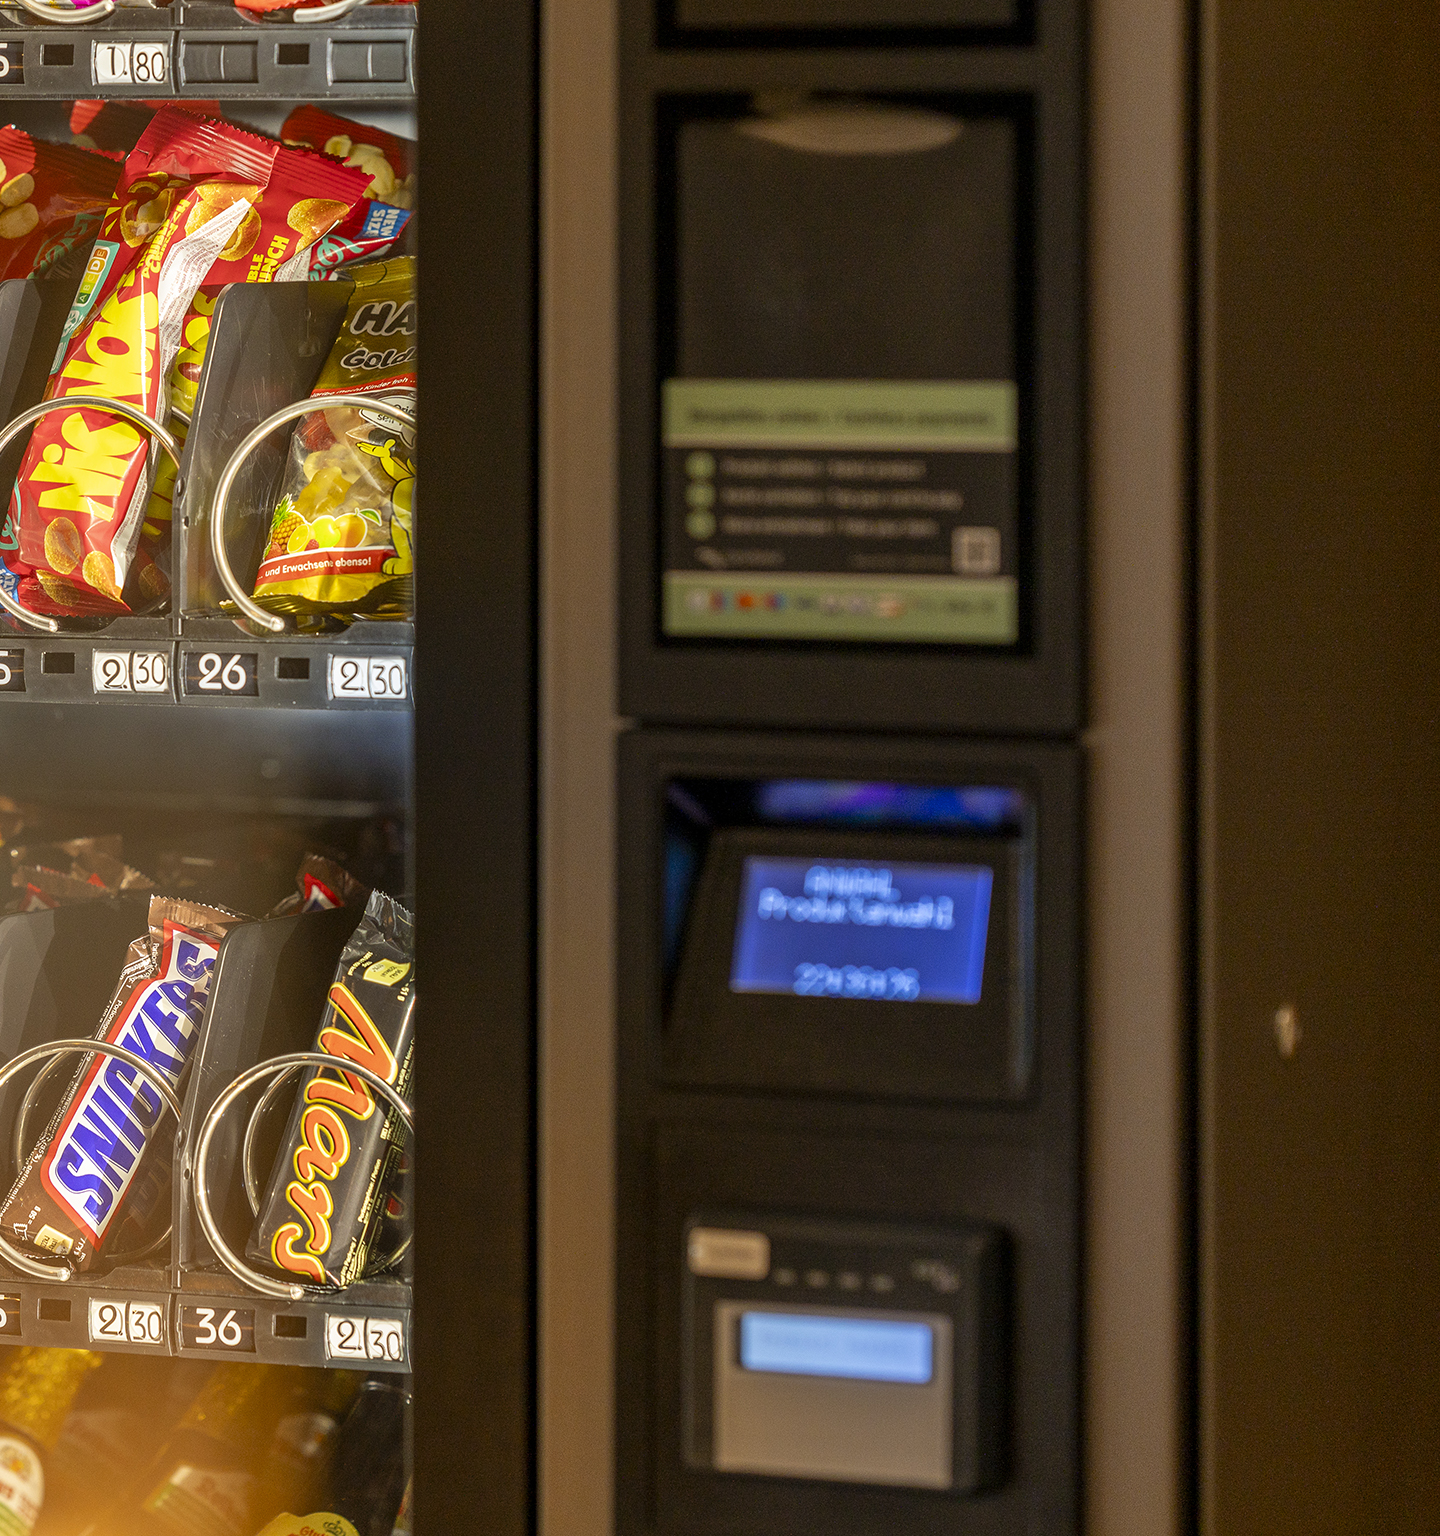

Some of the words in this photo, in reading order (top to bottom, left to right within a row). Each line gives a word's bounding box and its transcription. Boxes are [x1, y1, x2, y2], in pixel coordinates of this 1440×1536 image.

[264, 565, 281, 578] und
[335, 556, 372, 568] ebenso!
[198, 652, 247, 691] 26
[55, 939, 217, 1226] SNICKERS
[270, 981, 398, 1284] Mars
[195, 1307, 243, 1346] 36
